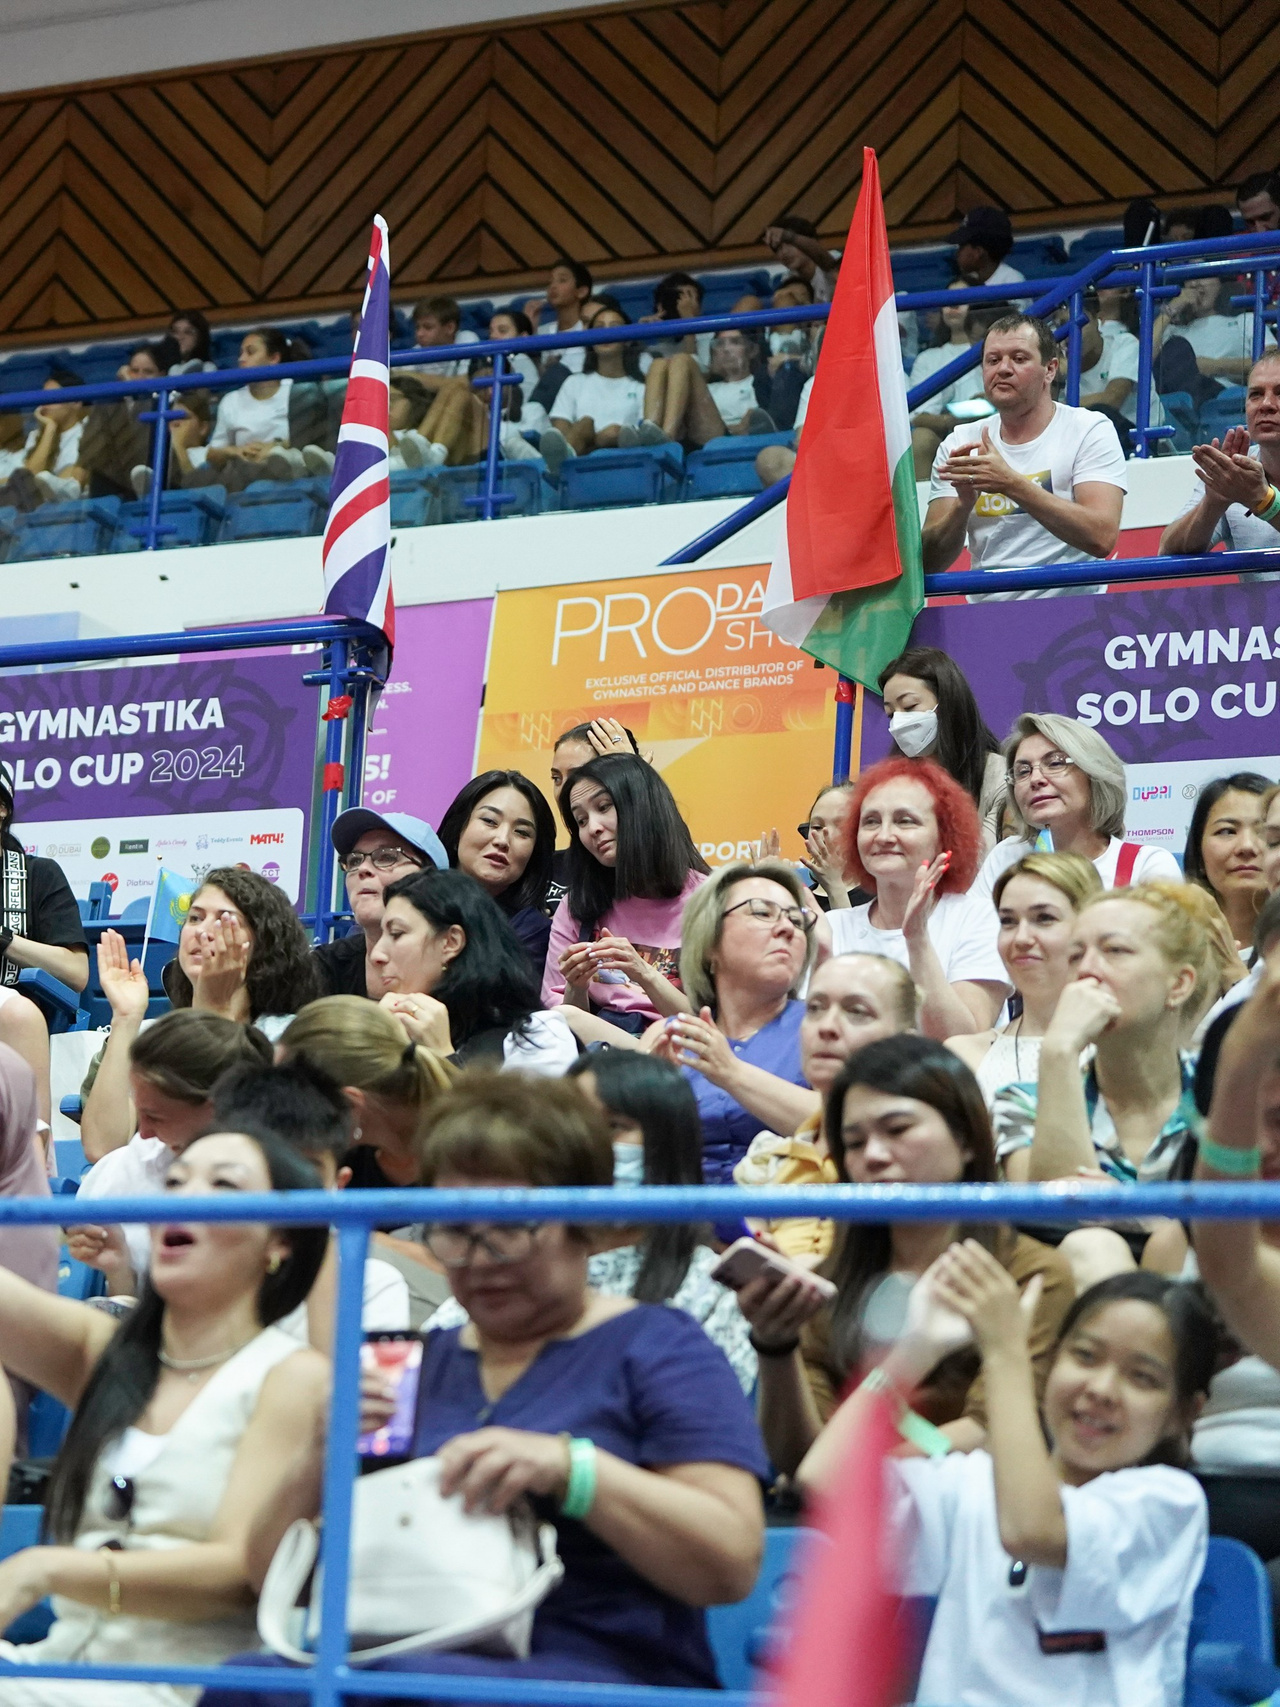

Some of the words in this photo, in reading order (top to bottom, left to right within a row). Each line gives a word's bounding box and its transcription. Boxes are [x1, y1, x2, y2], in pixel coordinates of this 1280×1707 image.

[551, 587, 716, 666] PRO
[585, 673, 647, 689] EXCLUSIVE
[649, 670, 702, 683] OFFICIAL
[705, 662, 784, 678] DISTRIBUTOR
[786, 659, 804, 671] OF
[593, 686, 667, 700] GYMNASTICS
[669, 682, 696, 693] AND
[698, 679, 740, 692] DANCE
[743, 674, 794, 688] BRANDS
[1076, 686, 1200, 727] SOLO
[69, 753, 144, 786] CUP
[150, 745, 244, 782] 2024
[371, 790, 397, 805] OF
[1126, 828, 1174, 837] THOMPSON
[261, 869, 280, 877] CCT
